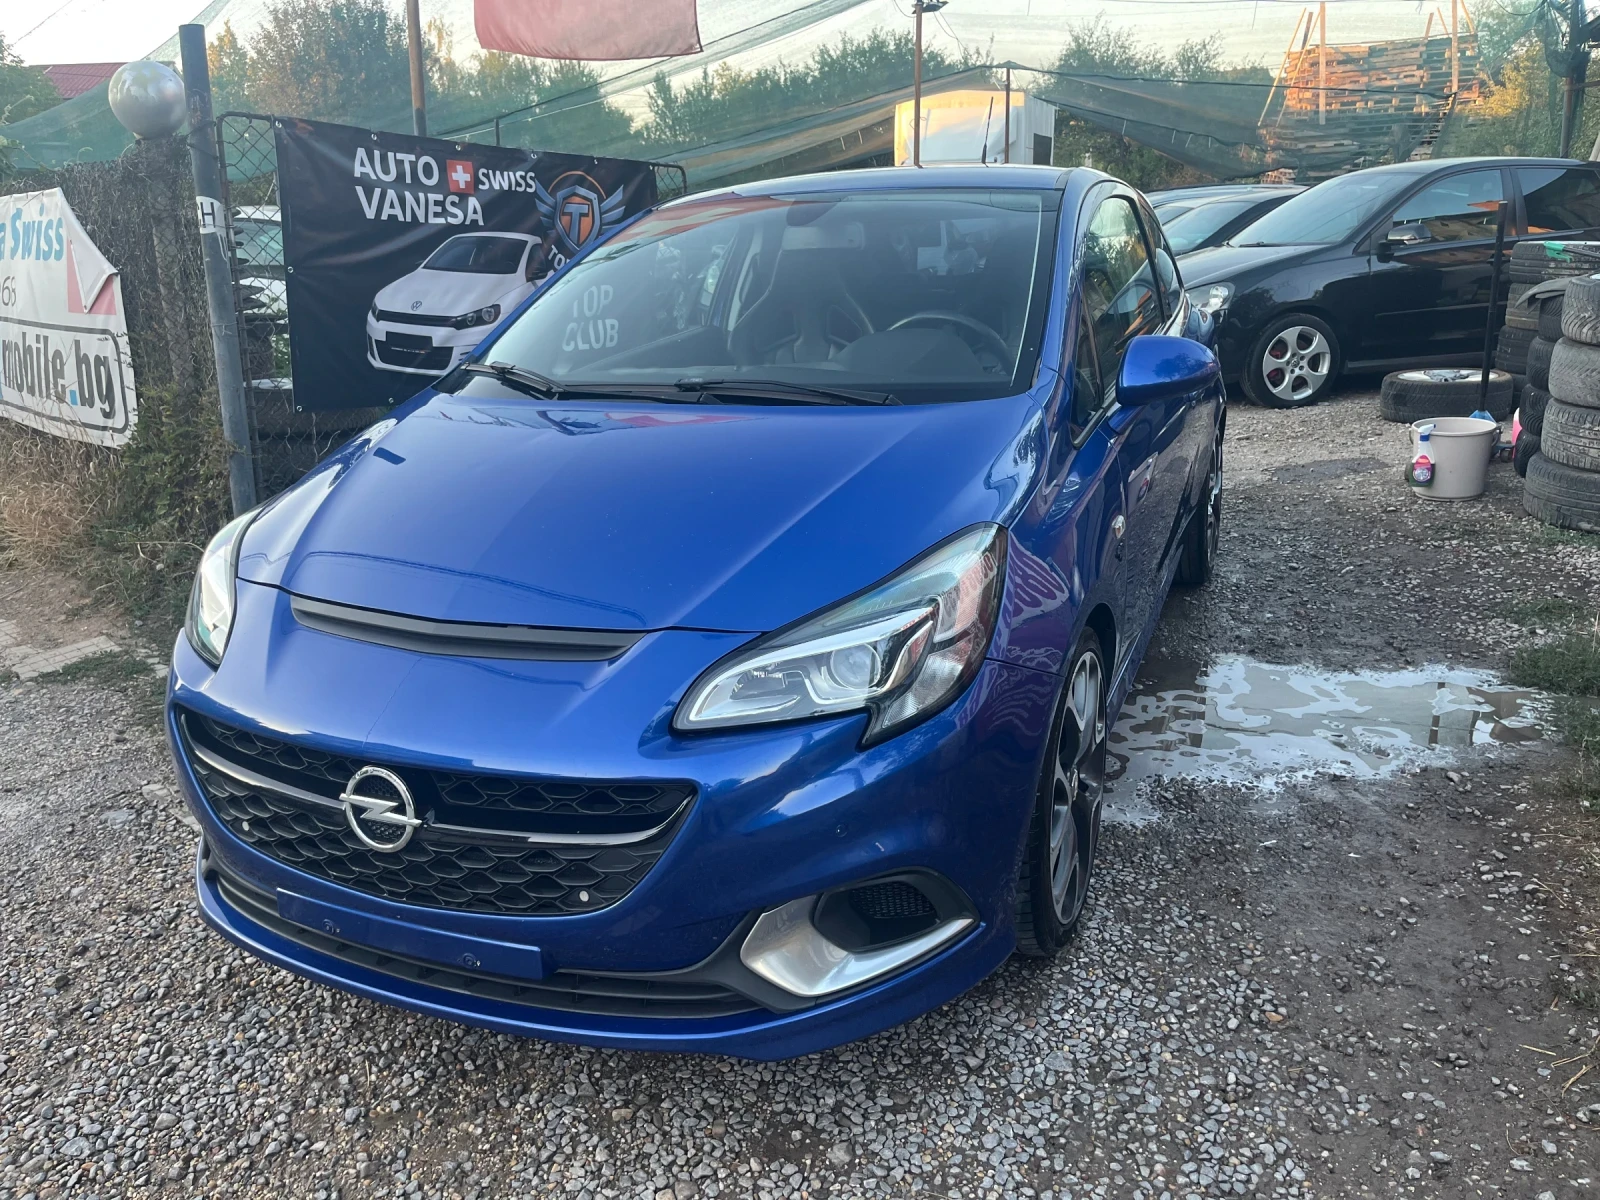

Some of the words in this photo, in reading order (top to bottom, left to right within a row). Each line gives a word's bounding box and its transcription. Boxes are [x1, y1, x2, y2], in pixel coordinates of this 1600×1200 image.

[354, 147, 440, 187] AUTO
[478, 168, 537, 193] SWISS
[355, 185, 485, 226] VANESA
[10, 203, 64, 262] Swiss
[547, 244, 571, 270] TO
[562, 318, 619, 352] CLUB
[2, 330, 116, 420] mobile.bg
